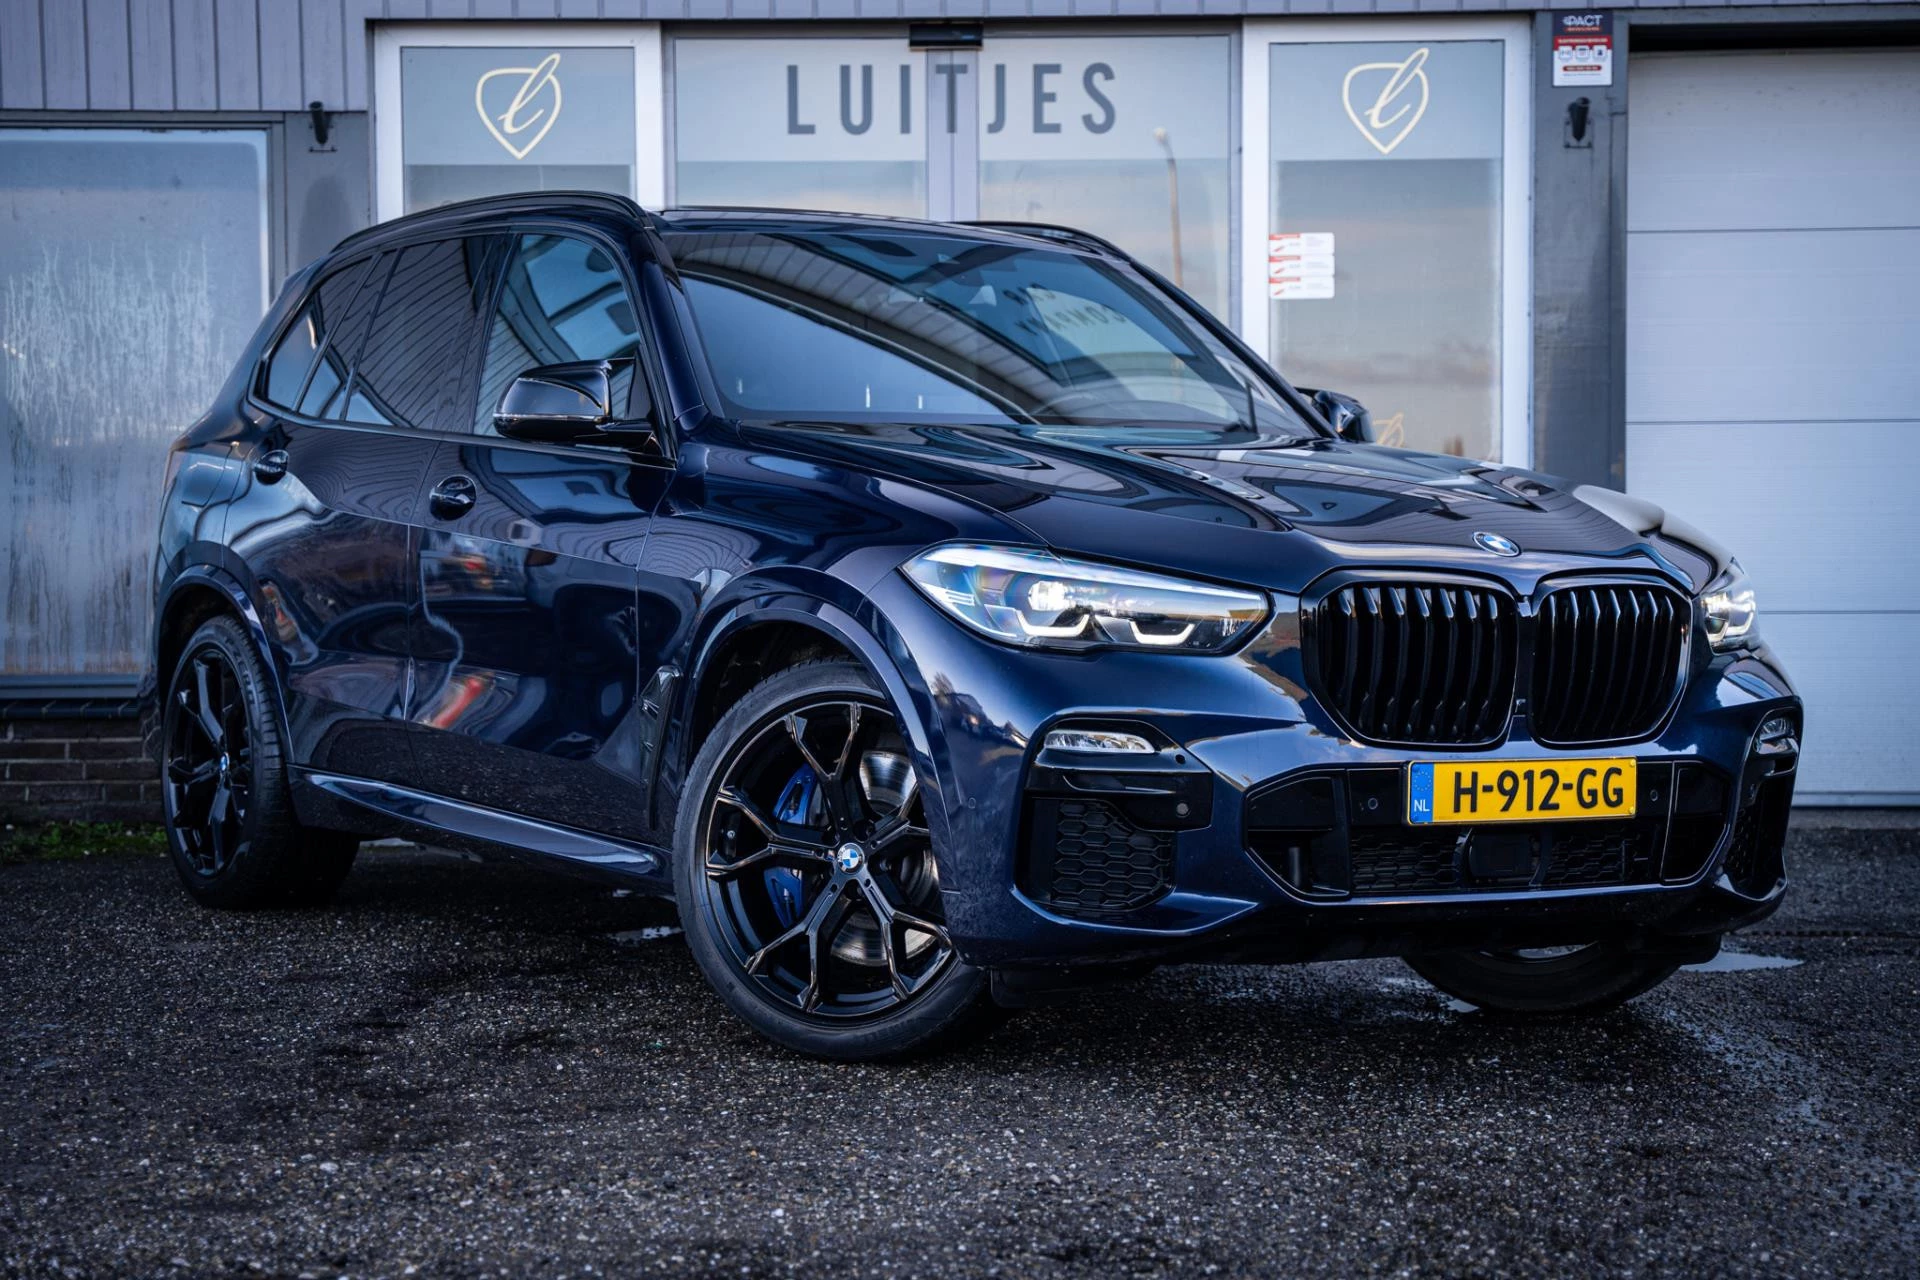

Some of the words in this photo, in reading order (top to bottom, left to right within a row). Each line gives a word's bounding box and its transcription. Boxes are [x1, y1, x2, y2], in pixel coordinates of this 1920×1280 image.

[787, 62, 1116, 135] LUITJES
[1413, 799, 1430, 813] NL
[1453, 767, 1624, 814] H-912-GG
